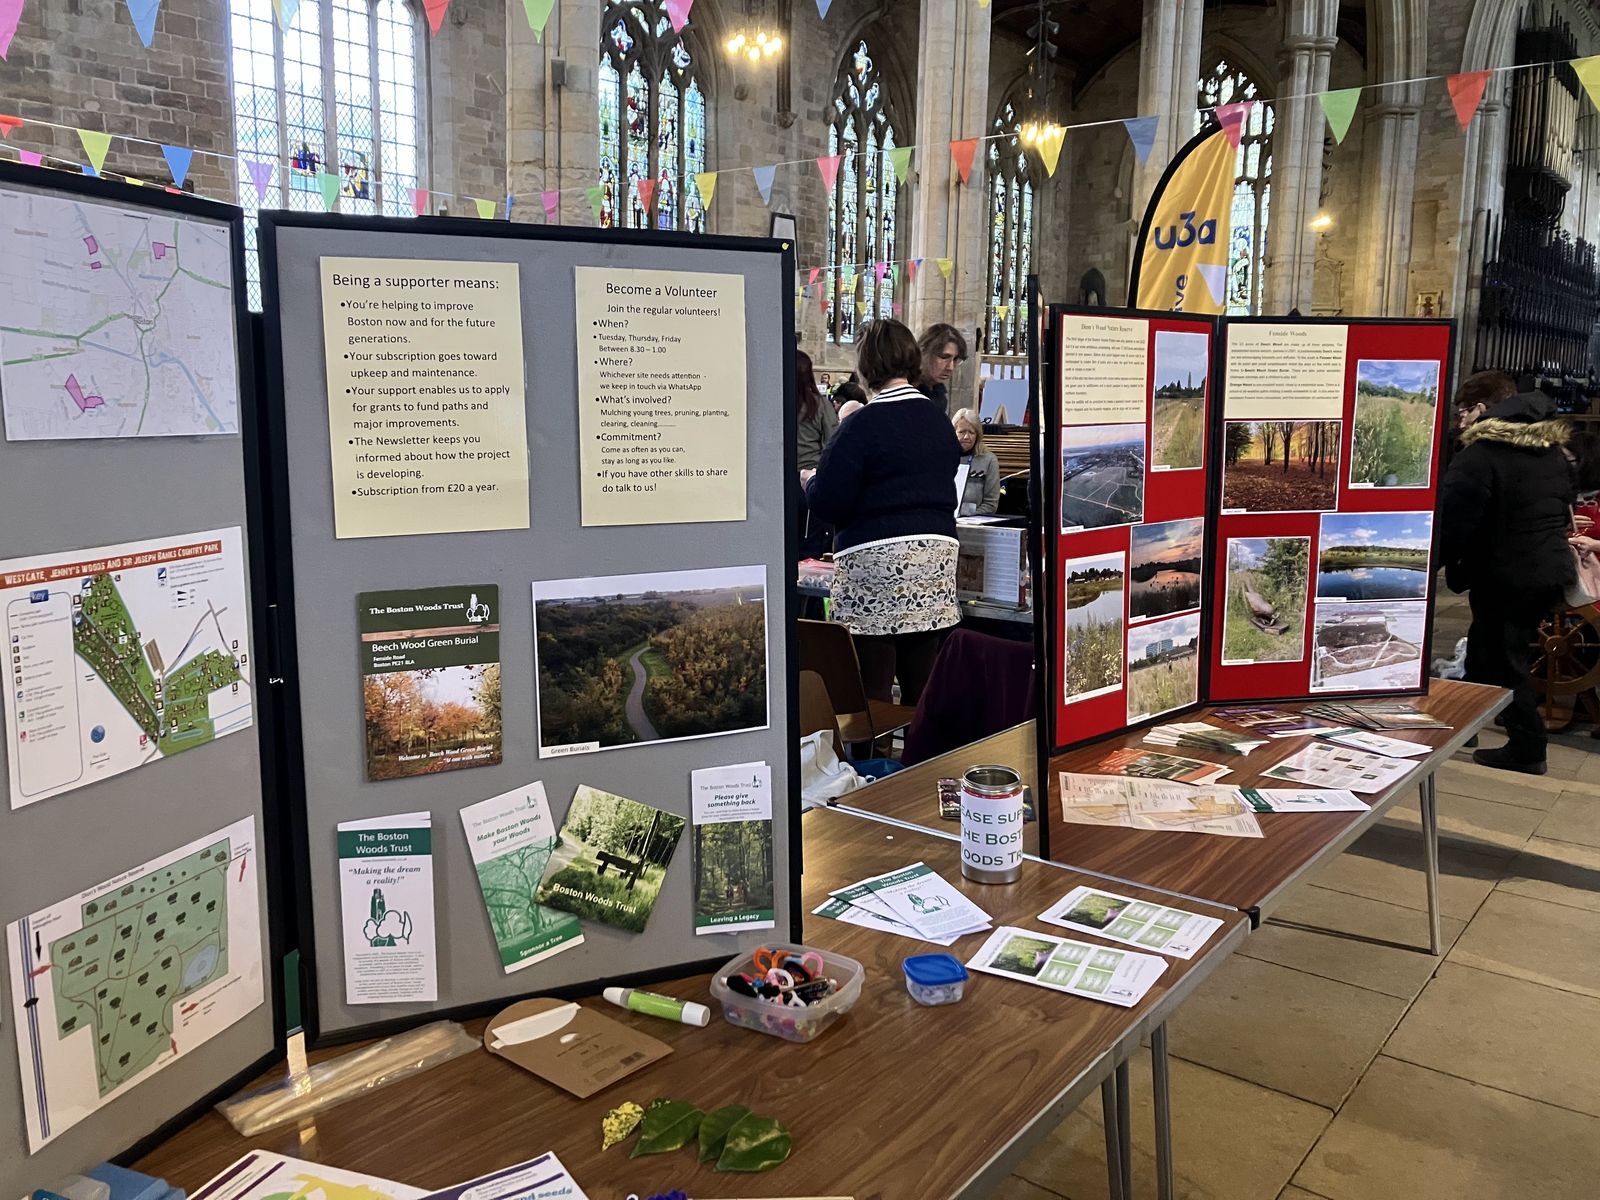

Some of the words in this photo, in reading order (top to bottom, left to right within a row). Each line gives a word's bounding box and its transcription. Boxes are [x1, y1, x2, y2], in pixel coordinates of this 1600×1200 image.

[1155, 211, 1216, 249] u3a
[333, 274, 370, 288] Being
[375, 278, 381, 286] a
[386, 277, 449, 289] supporter
[454, 280, 499, 288] means:
[606, 283, 651, 295] Become
[665, 286, 717, 298] Volunteer
[346, 300, 379, 309] You're
[382, 301, 418, 312] helping
[434, 302, 474, 312] improve
[608, 304, 624, 313] Join
[627, 305, 640, 313] the
[643, 306, 672, 316] regular
[675, 307, 720, 316] volunteers!
[348, 317, 382, 326] Boston
[410, 318, 427, 327] and
[431, 318, 444, 327] for
[448, 319, 463, 327] the
[466, 319, 495, 328] future
[349, 334, 411, 344] generations.
[599, 334, 626, 342] Tuesday,
[629, 335, 660, 343] Thursday,
[350, 352, 372, 360] Your
[376, 352, 435, 362] subscription
[439, 353, 460, 362] goes
[464, 352, 497, 360] toward
[351, 369, 388, 379] upkeep
[390, 369, 409, 377] and
[352, 386, 374, 395] Your
[378, 387, 416, 396] support
[419, 386, 456, 394] enables
[485, 386, 510, 395] apply
[353, 403, 367, 412] for
[370, 404, 400, 413] grants
[417, 402, 439, 411] fund
[442, 402, 468, 412] paths
[471, 402, 488, 410] and
[354, 420, 382, 430] major
[386, 419, 460, 430] improvements.
[376, 436, 430, 445] Newsletter
[433, 436, 460, 445] keeps
[601, 433, 661, 441] Commitment?
[356, 453, 401, 462] informed
[404, 452, 433, 461] about
[436, 452, 456, 460] how
[459, 451, 474, 459] the
[478, 451, 510, 460] project
[357, 470, 364, 478] is
[367, 470, 424, 480] developing.
[358, 487, 418, 497] Subscription
[422, 485, 444, 494] from
[448, 484, 465, 492] £20
[476, 484, 499, 493] year.
[644, 483, 657, 492] us!
[107, 558, 120, 569] AND
[123, 557, 132, 566] SIR
[134, 554, 157, 565] JOSEPH
[158, 550, 177, 560] BANKS
[178, 546, 203, 557] COUNTRY
[204, 543, 218, 552] PARK
[372, 642, 398, 652] Beech
[400, 641, 425, 650] Wood
[428, 639, 453, 647] Green
[455, 636, 478, 645] Burial
[477, 830, 495, 842] Make
[496, 821, 519, 836] Boston
[520, 814, 541, 826] Woods
[493, 836, 507, 847] your
[508, 827, 530, 839] Woods
[356, 845, 387, 854] Woods
[553, 883, 584, 899] Boston
[585, 892, 613, 907] Woods
[615, 901, 636, 914] Trust
